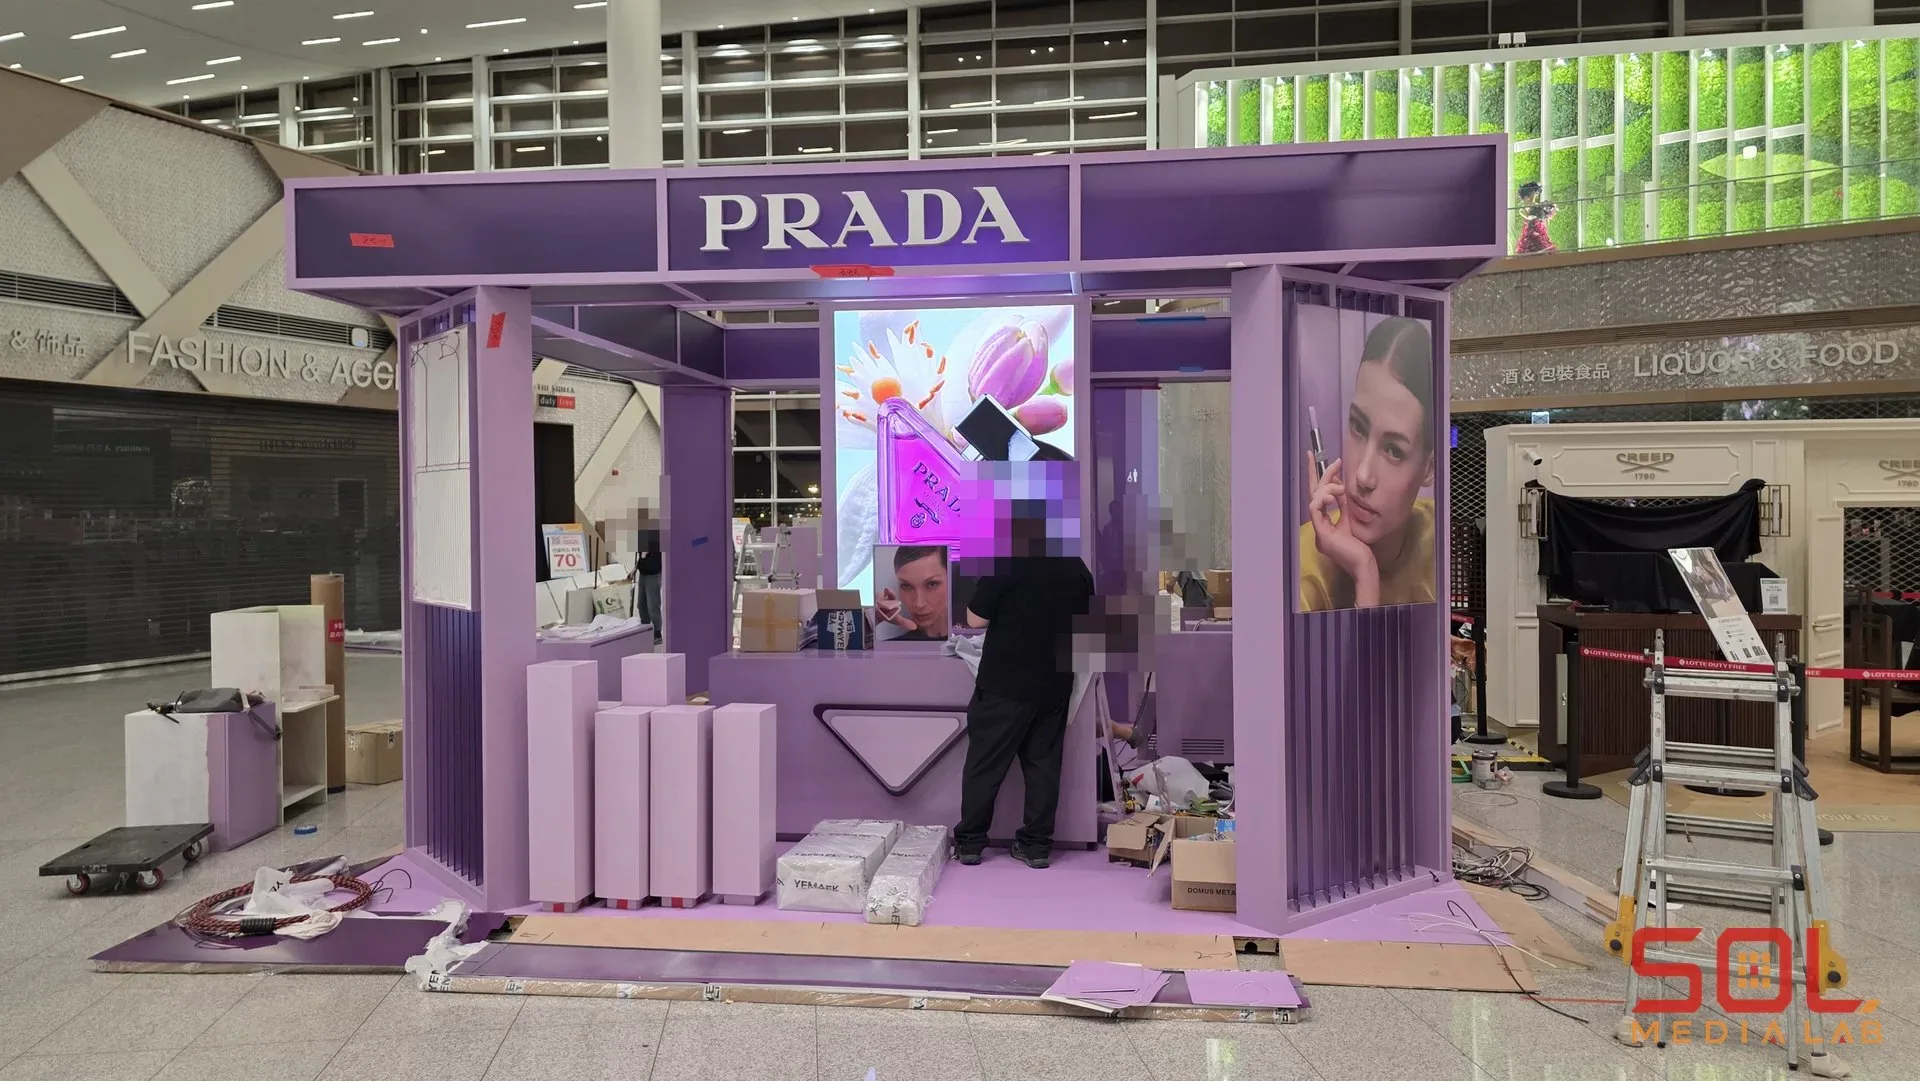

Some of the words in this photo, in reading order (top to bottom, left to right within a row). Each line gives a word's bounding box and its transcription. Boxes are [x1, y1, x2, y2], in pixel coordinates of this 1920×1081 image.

[699, 186, 1030, 251] PRADA
[9, 329, 29, 350] &
[127, 330, 291, 379] FASHION
[300, 352, 321, 383] &
[1634, 349, 1756, 378] LIQUOR
[1765, 348, 1789, 370] &
[1800, 340, 1899, 368] FOOD
[1500, 368, 1519, 385] 酒
[1522, 368, 1536, 382] &
[1616, 452, 1674, 468] CREED
[913, 462, 960, 512] PRAD
[1187, 887, 1214, 895] DOMUS
